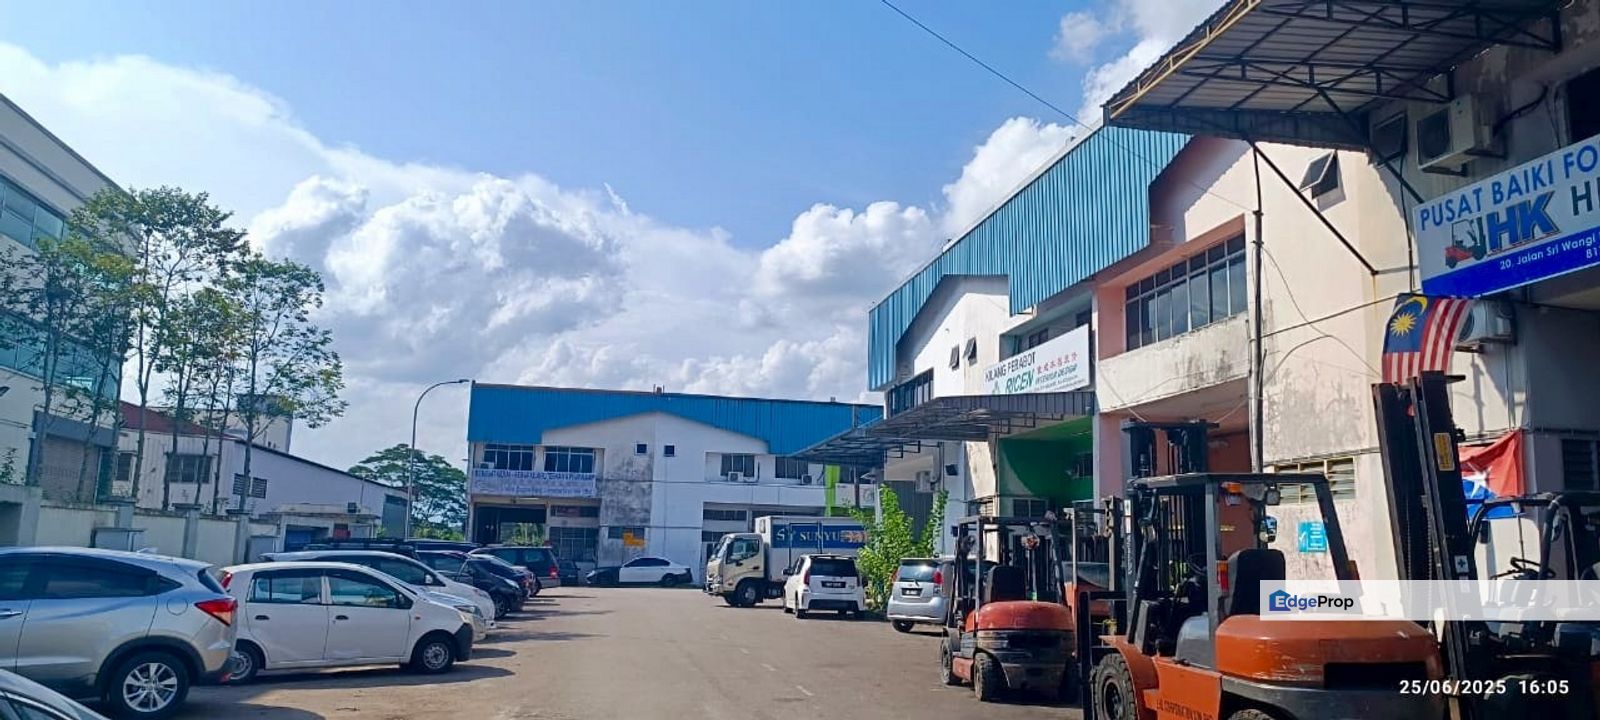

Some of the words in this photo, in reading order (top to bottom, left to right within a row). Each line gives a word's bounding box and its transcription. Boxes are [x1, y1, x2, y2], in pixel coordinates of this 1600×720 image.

[1420, 187, 1483, 231] PUSAT
[1491, 160, 1554, 205] BAIKI
[1563, 140, 1600, 179] FO
[1486, 190, 1560, 253] HK
[1571, 176, 1600, 216] H
[1517, 251, 1544, 265] Jalan
[1546, 244, 1559, 257] Sri
[1561, 233, 1595, 251] Wangi
[1586, 246, 1600, 259] 81
[984, 364, 1007, 382] KILANG
[1007, 351, 1036, 373] PERABOT
[1005, 369, 1035, 393] RICEN
[800, 531, 842, 541] SUNYU
